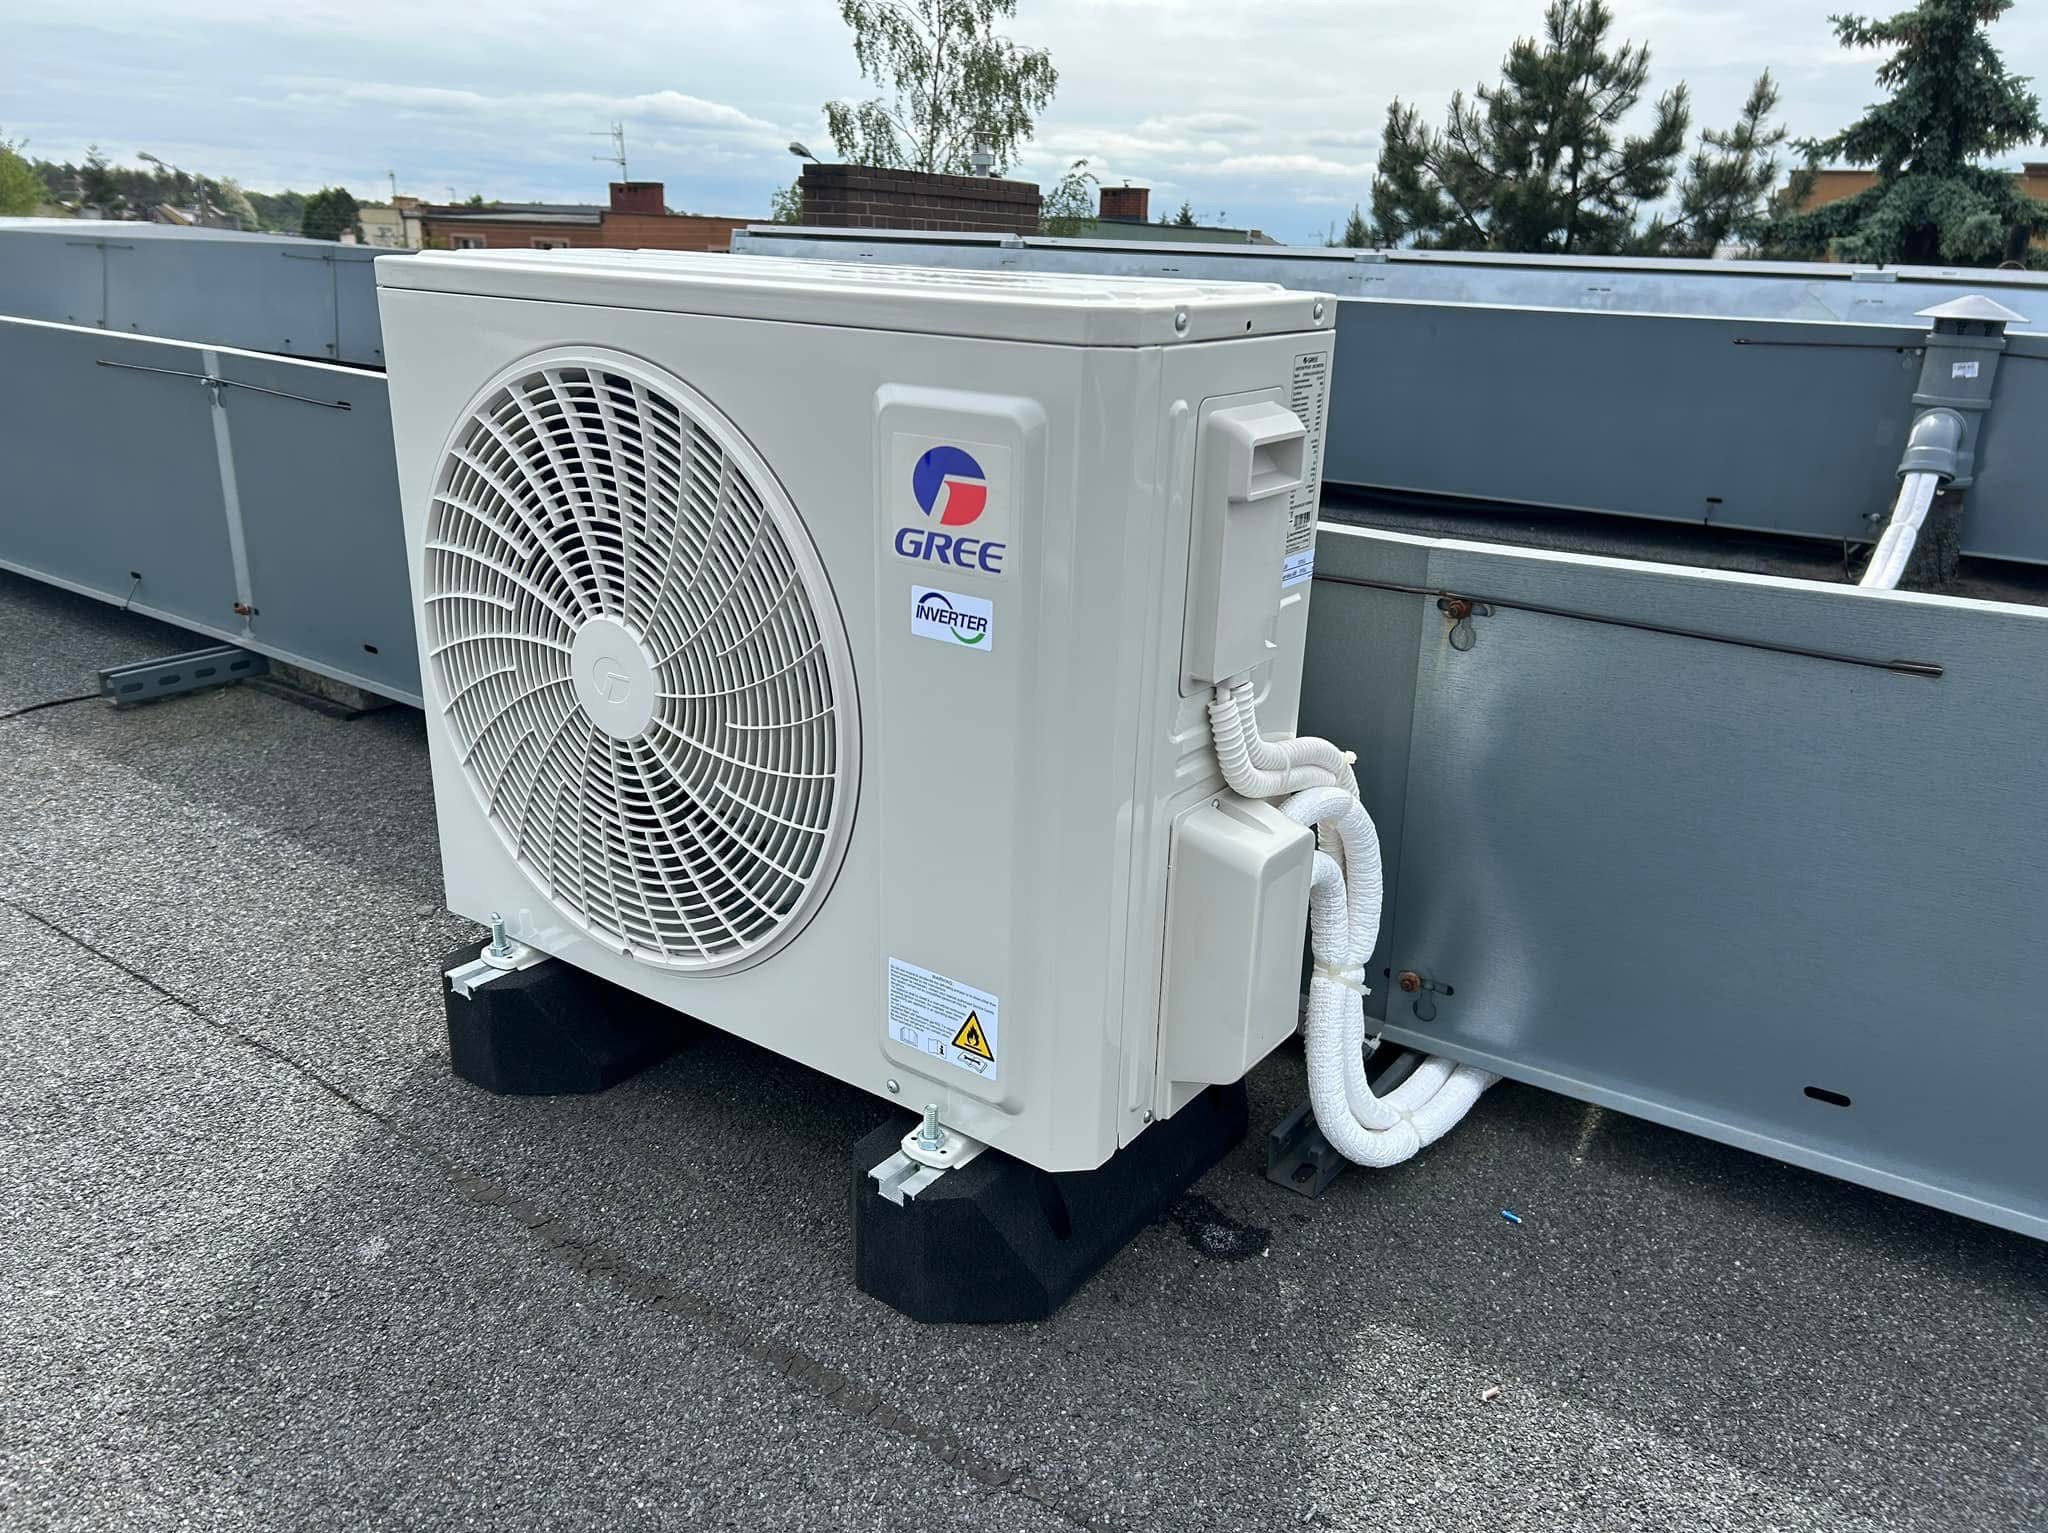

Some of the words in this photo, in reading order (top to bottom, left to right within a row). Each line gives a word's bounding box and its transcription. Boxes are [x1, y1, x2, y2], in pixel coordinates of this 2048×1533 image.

[894, 527, 1006, 574] GREE
[915, 603, 988, 633] INVERTER
[932, 974, 953, 986] WARNING
